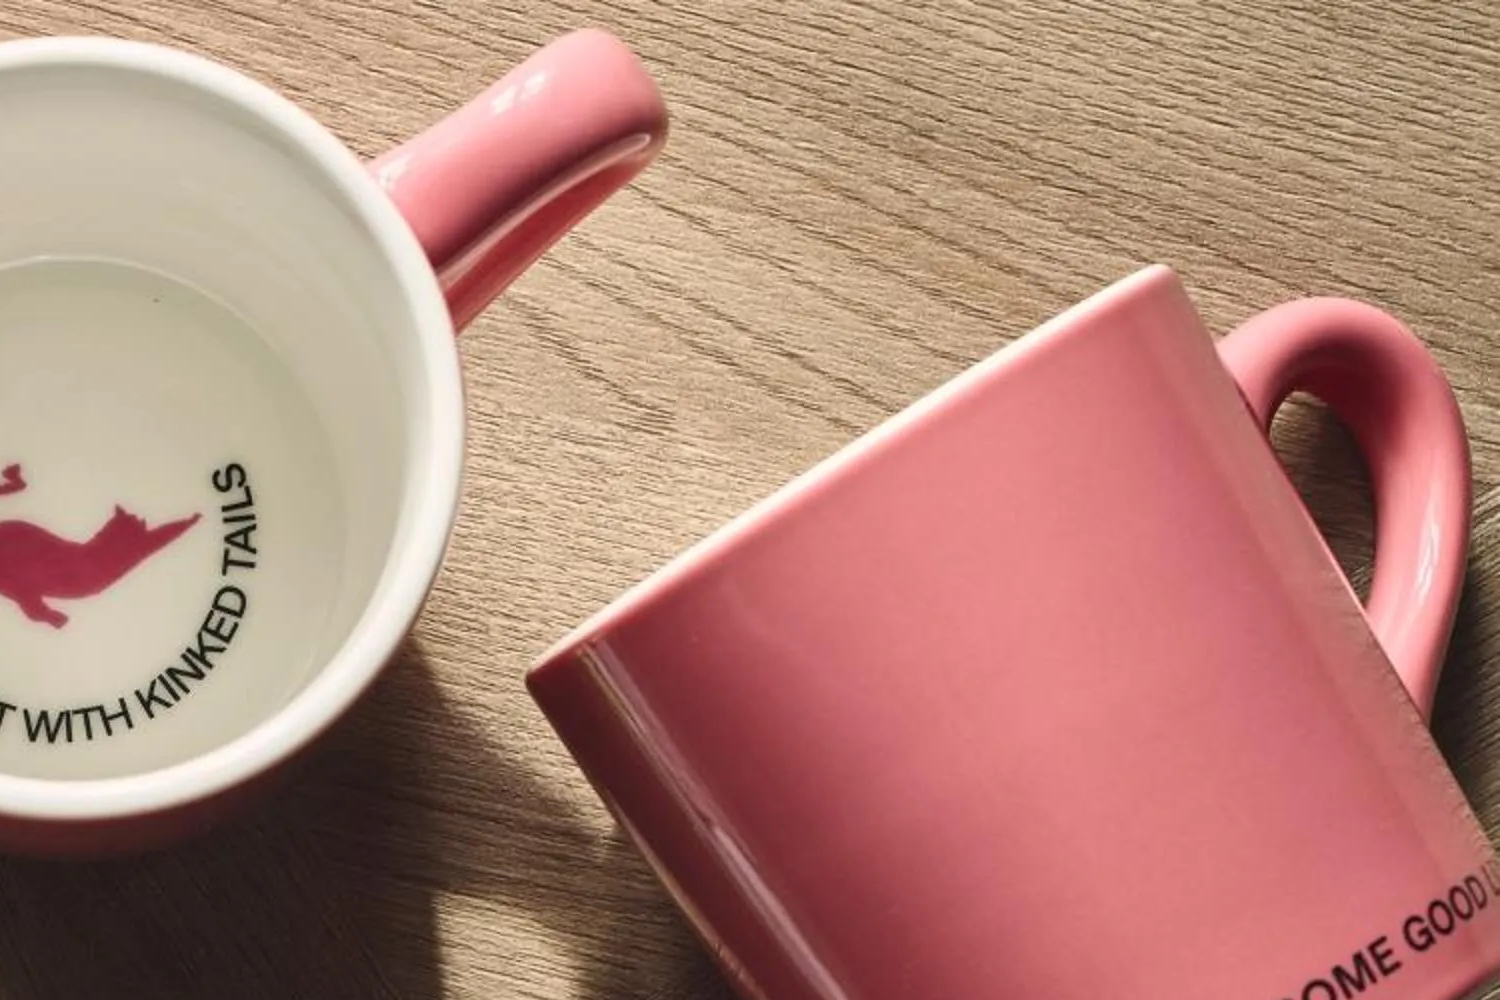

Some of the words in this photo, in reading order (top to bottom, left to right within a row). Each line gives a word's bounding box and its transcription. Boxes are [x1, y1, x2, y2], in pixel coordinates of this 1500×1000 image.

[23, 696, 134, 744] WITH
[134, 585, 248, 719] KINKED
[211, 462, 258, 577] TAILS
[1402, 875, 1488, 952] GOOD
